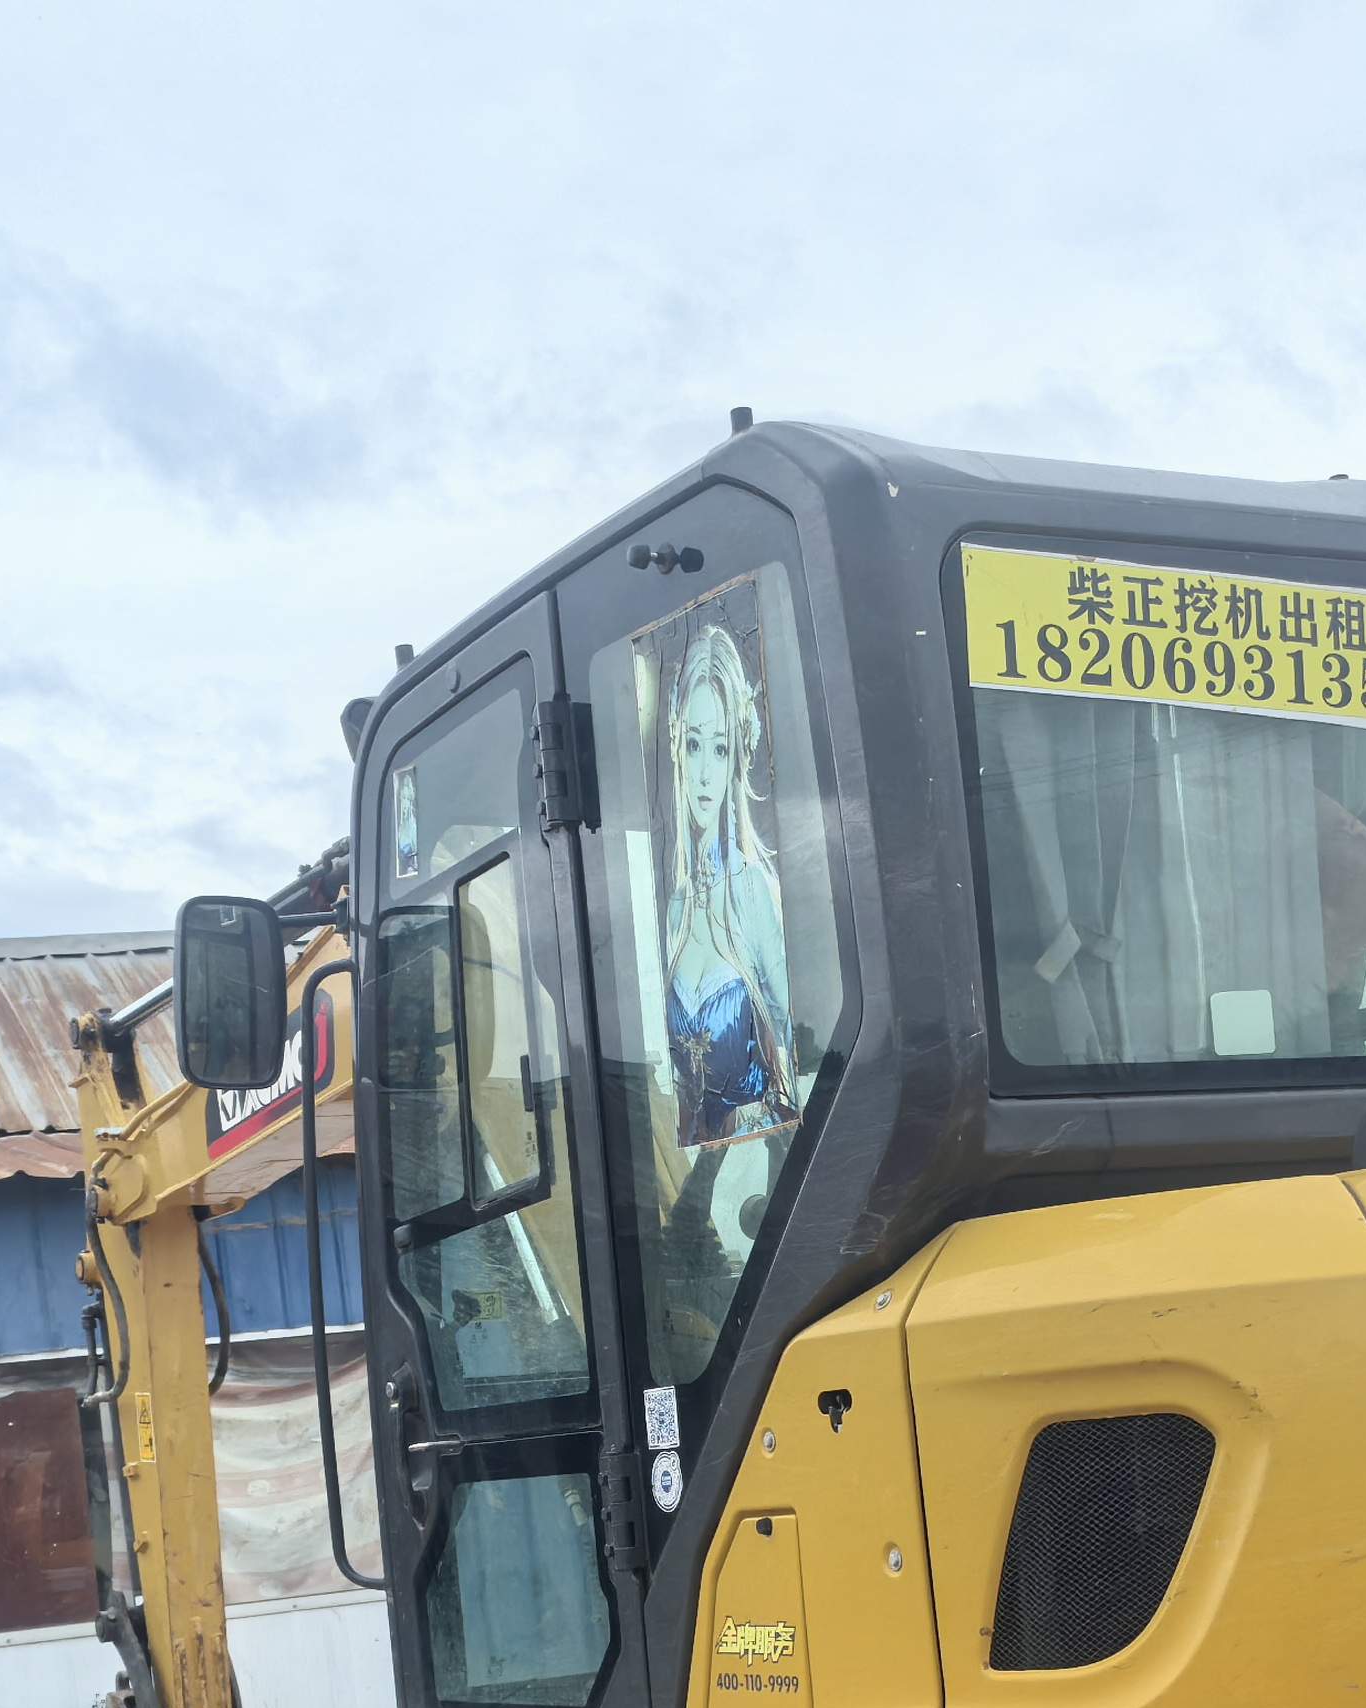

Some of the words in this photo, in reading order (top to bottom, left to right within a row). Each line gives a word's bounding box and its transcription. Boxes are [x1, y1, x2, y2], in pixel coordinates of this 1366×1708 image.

[715, 1616, 795, 1667] 金牌服务
[717, 1673, 799, 1693] 400-110-9999
